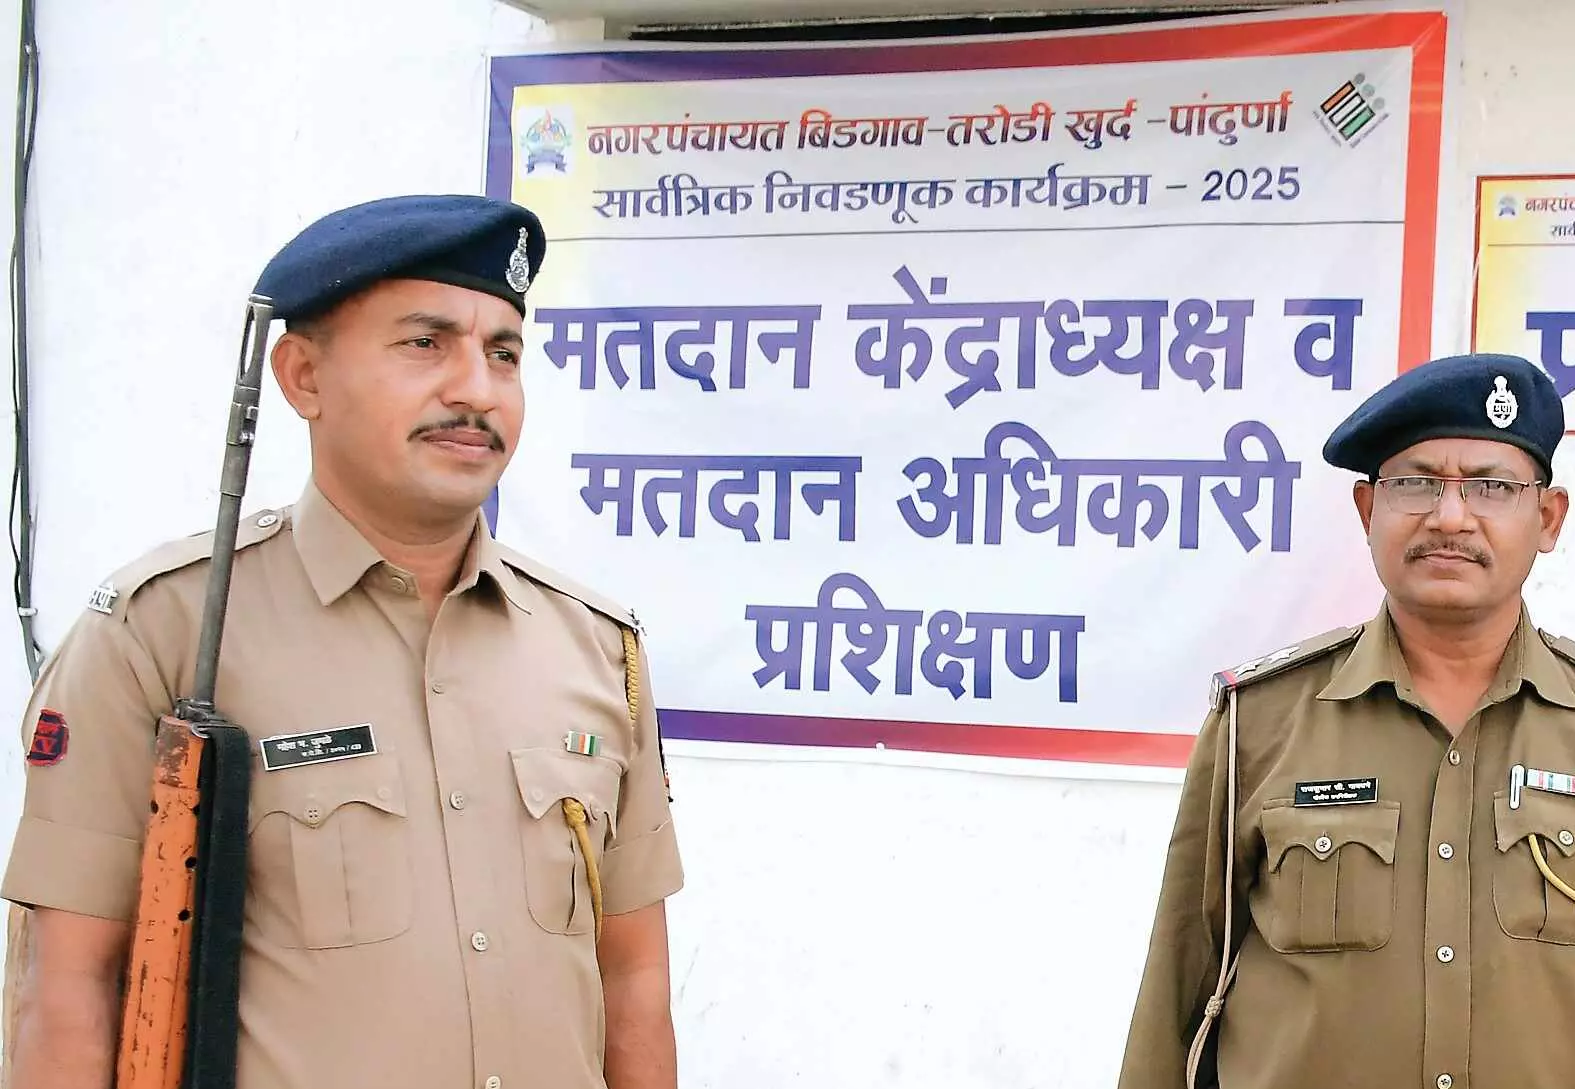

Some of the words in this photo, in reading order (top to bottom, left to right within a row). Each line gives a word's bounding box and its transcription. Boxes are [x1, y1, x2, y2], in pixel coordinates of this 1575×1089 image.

[587, 112, 790, 154] नगरपंचायत
[1065, 97, 1138, 149] खुर्द
[593, 173, 754, 218] सार्वत्रिक
[762, 170, 957, 224] निवडणूक
[965, 162, 1152, 210] कार्यक्रम
[1201, 165, 1301, 202] 2025
[534, 304, 823, 393] मतदान
[846, 264, 1255, 411] केंद्राध्यक्ष
[1284, 298, 1364, 391] व
[571, 453, 863, 543] मतदान
[896, 420, 1302, 554] अधिकारी
[744, 572, 1086, 704] प्रशिक्षण
